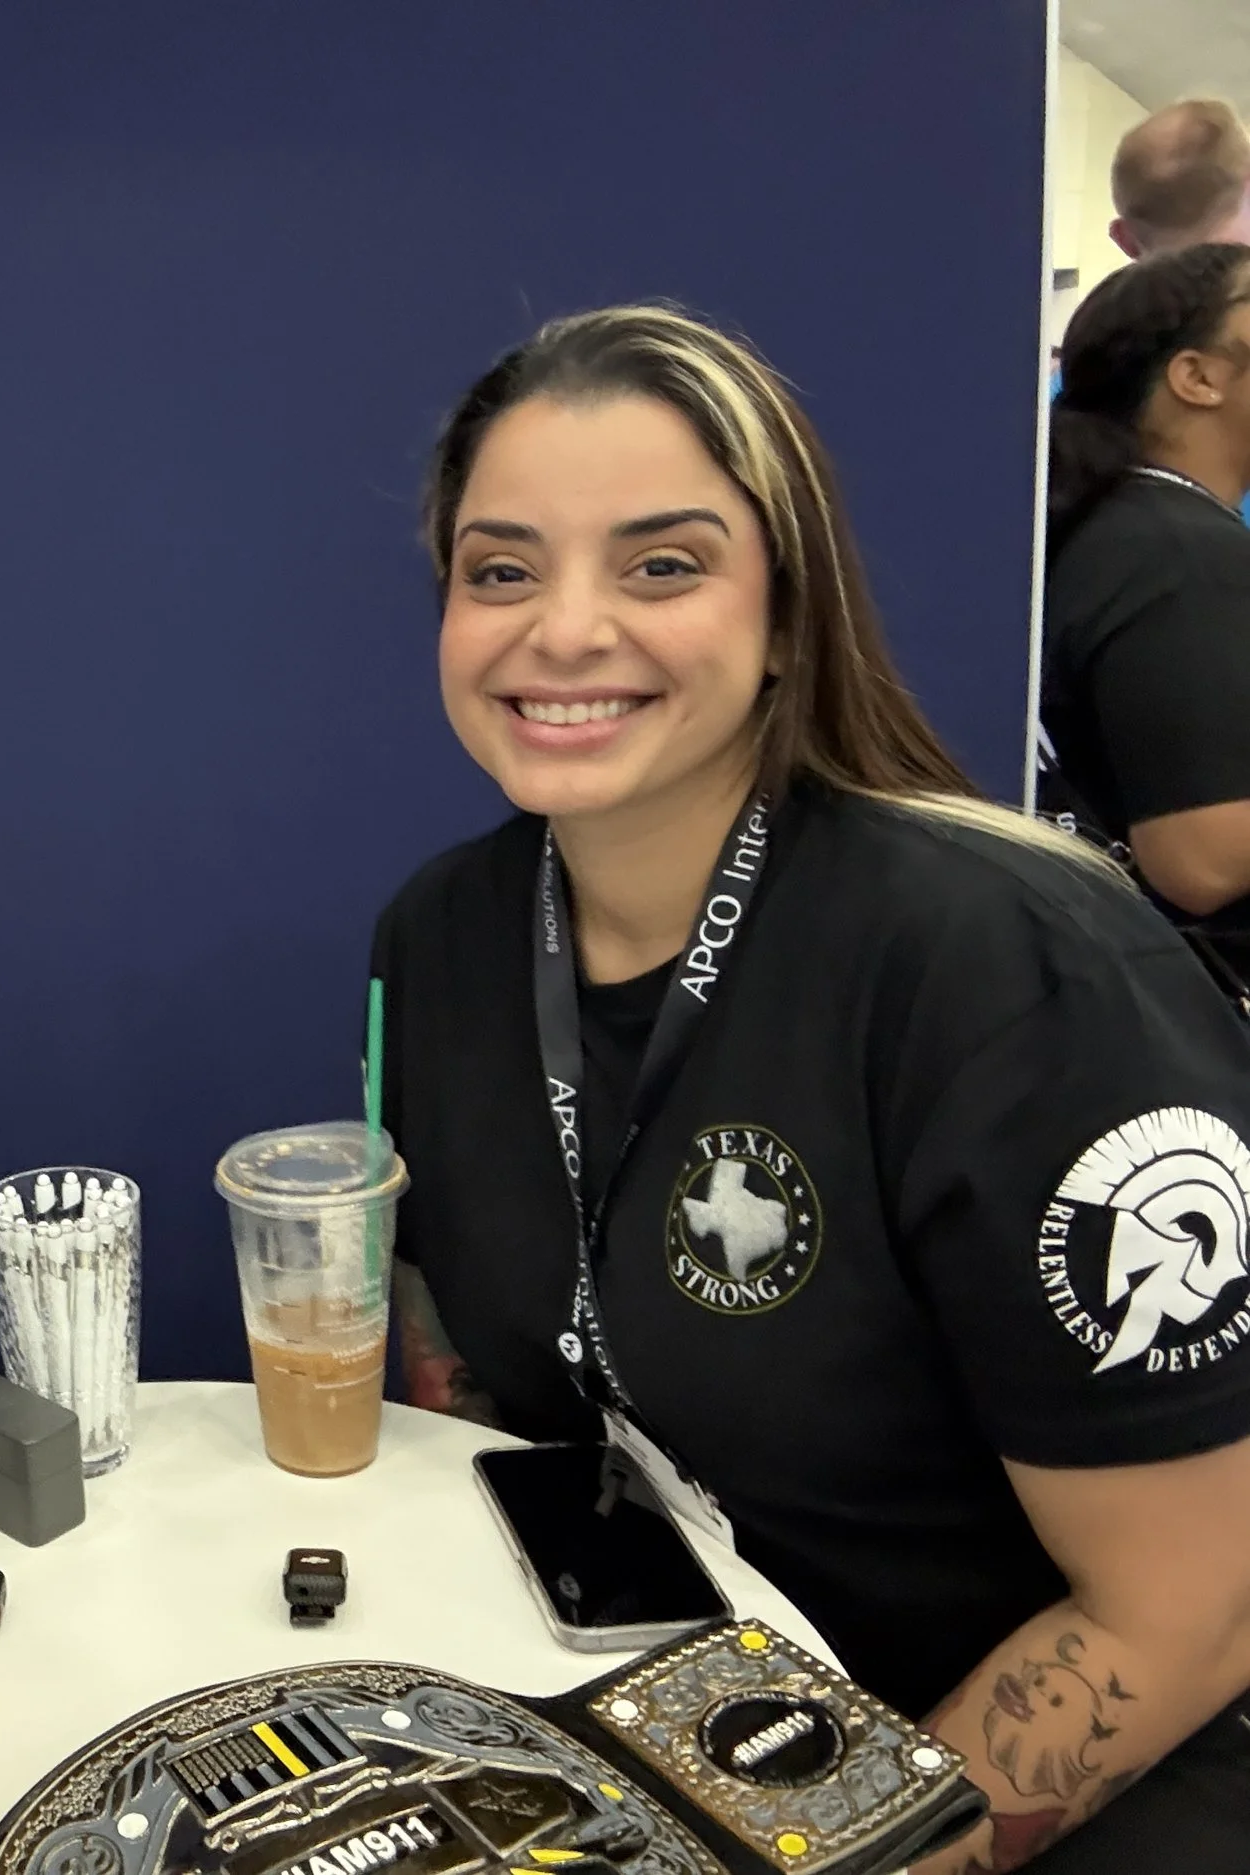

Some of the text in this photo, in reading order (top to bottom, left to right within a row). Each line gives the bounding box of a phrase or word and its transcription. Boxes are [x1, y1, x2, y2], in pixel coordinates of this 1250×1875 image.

[680, 894, 742, 1003] APCO
[548, 1076, 580, 1179] APCO
[696, 1130, 793, 1177] TEXAS
[672, 1254, 781, 1308] STRONG
[1037, 1202, 1114, 1355] RELENTLESS
[1146, 1293, 1250, 1373] DEFEND
[280, 1815, 440, 1875] AM911
